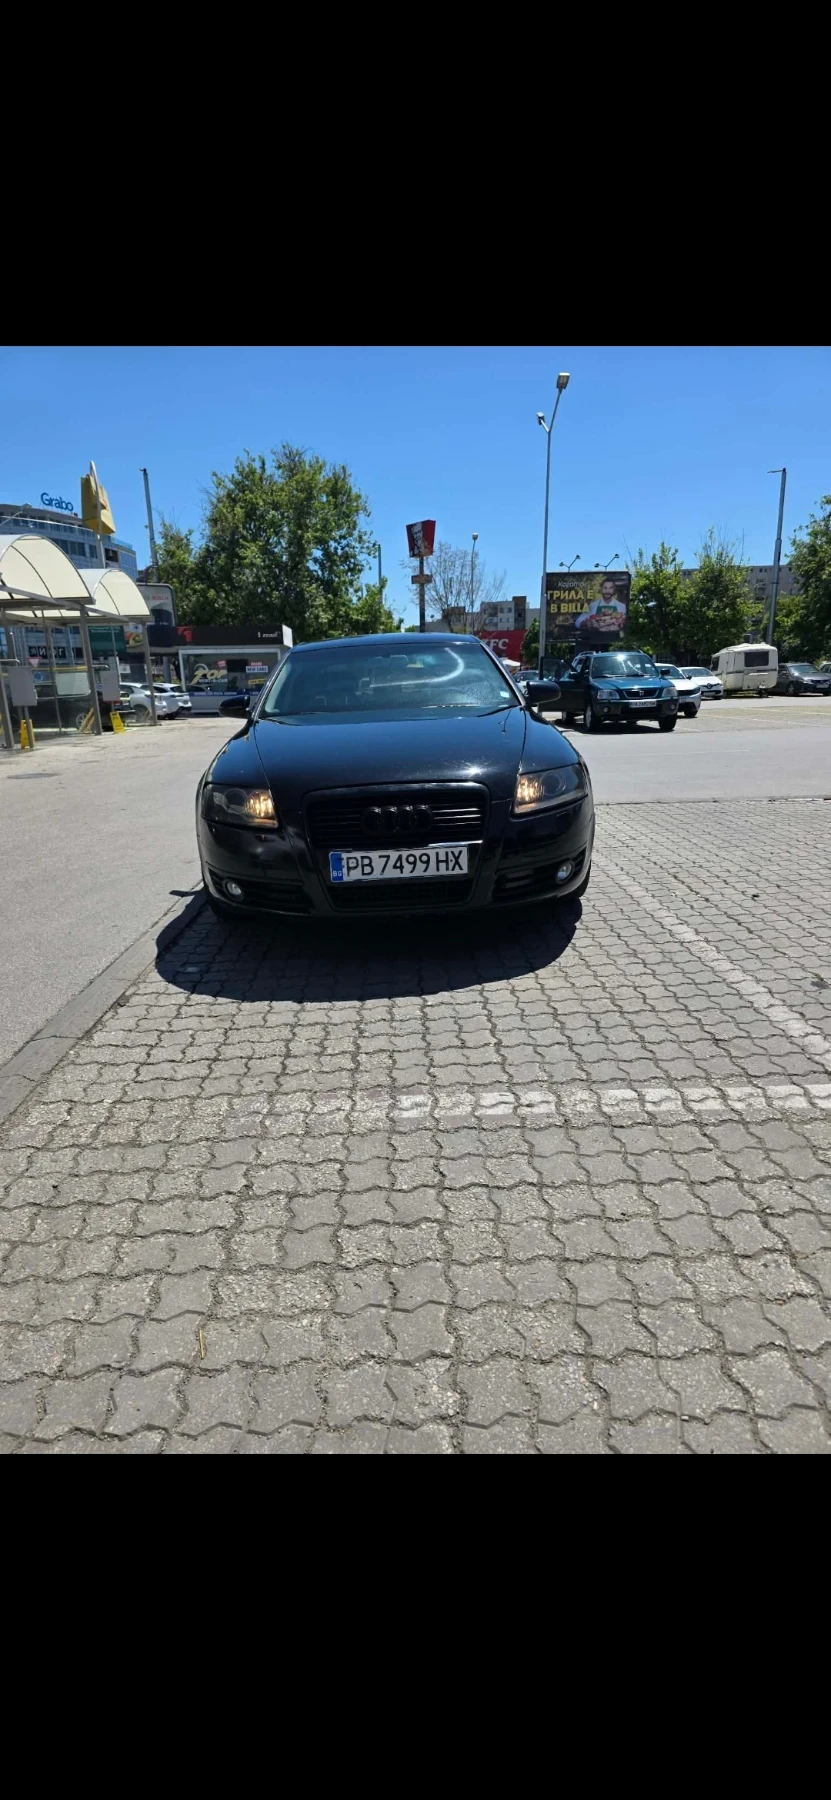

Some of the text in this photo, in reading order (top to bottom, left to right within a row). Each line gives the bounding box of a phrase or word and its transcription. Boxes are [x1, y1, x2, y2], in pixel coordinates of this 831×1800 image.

[41, 492, 74, 511] Grabo
[547, 590, 584, 600] ГРИЛА
[560, 602, 590, 613] BILLA
[346, 856, 374, 877] PB
[378, 853, 431, 876] 7499
[435, 850, 463, 872] HX
